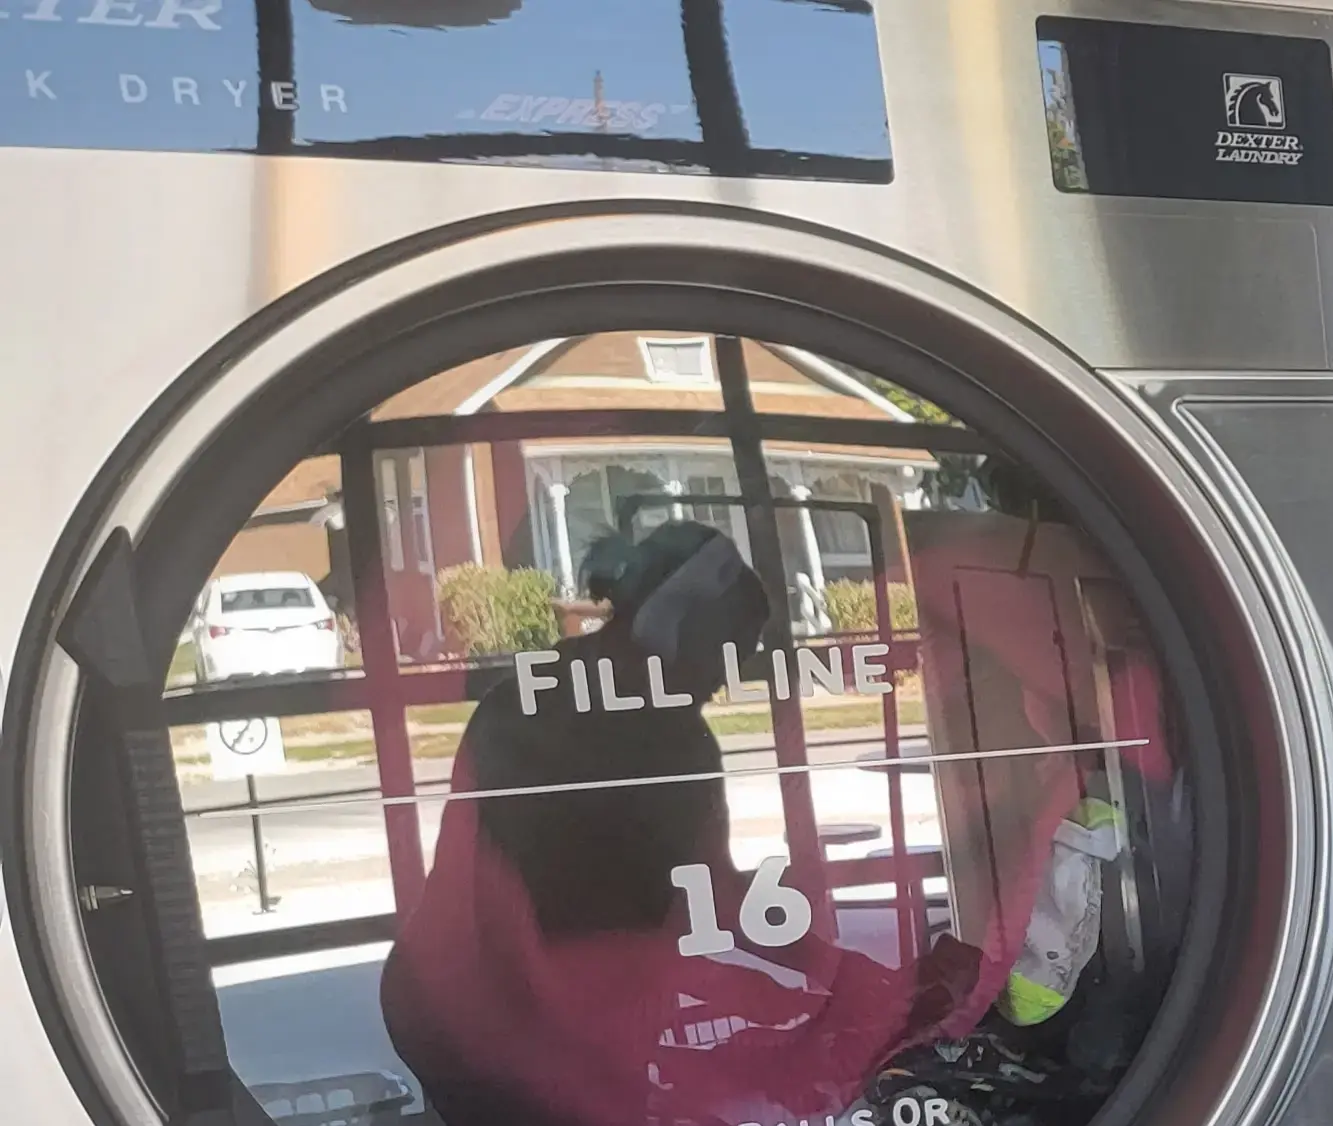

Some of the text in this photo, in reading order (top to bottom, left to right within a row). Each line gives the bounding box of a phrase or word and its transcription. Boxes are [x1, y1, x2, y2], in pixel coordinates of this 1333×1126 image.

[119, 74, 348, 114] DRYER
[480, 93, 667, 131] EXPRESS
[1214, 132, 1302, 151] DEXTER
[1215, 148, 1304, 166] LAUNDRY
[513, 640, 896, 716] FILL LINE
[669, 855, 813, 957] 16
